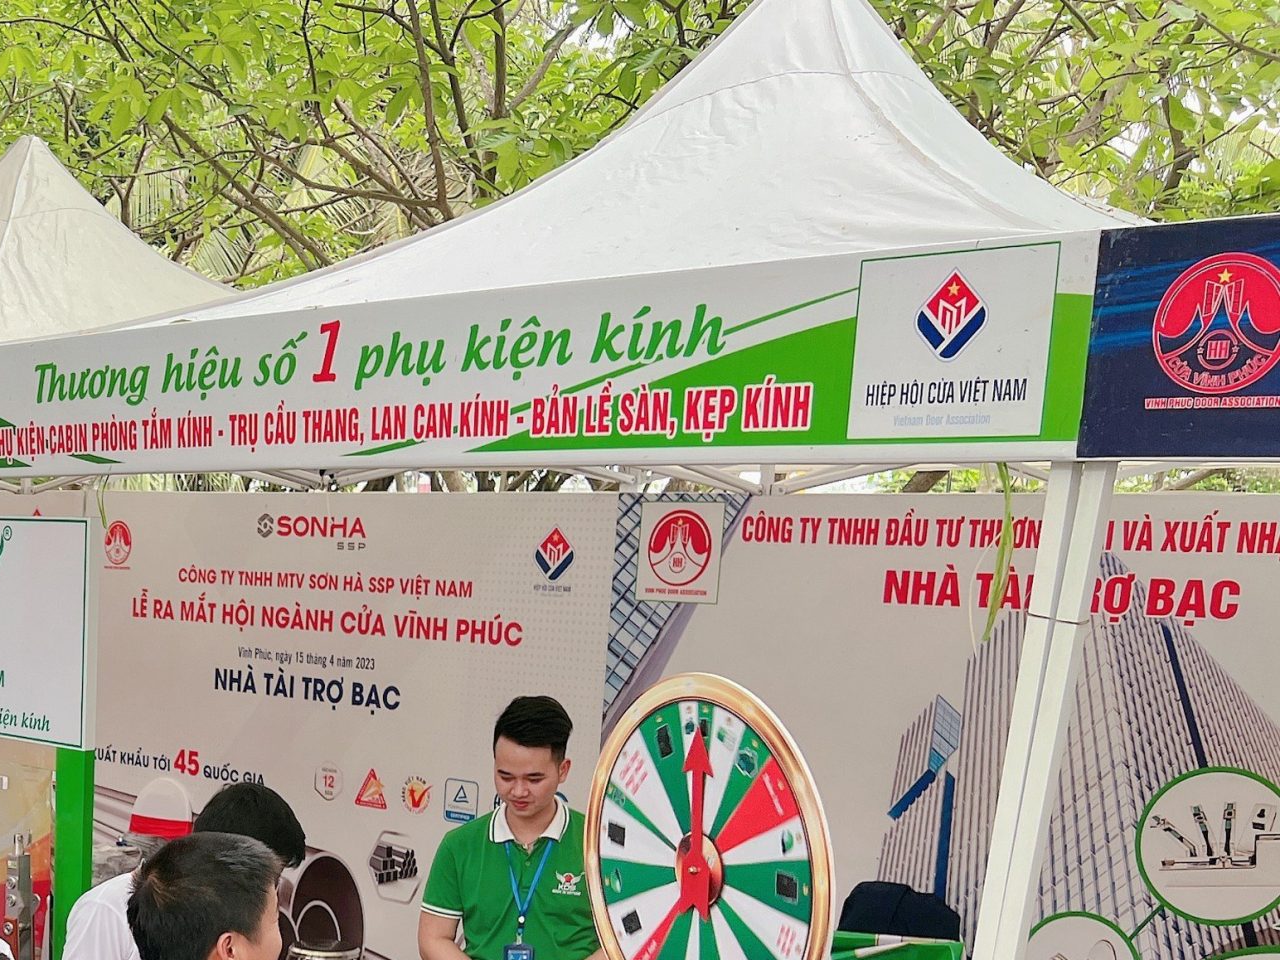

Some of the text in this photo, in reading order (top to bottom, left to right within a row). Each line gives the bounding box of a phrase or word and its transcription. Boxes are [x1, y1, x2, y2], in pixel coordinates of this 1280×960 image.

[34, 304, 726, 407] Thương hiệu số 1 phụ kiện kính
[866, 376, 1028, 408] HIỆP HỘI CỬA VIỆT NAM
[1145, 396, 1280, 409] VINH PHUC DOOR ASSOCIATION
[92, 414, 137, 451] PHÒNG
[142, 407, 172, 450] TẮM
[178, 410, 212, 448] KÍNH
[229, 413, 258, 453] TRỤ
[264, 400, 297, 445] CẦU
[303, 408, 364, 446] THANG,
[371, 404, 407, 441] LAN
[531, 384, 578, 436] BẢN
[584, 381, 615, 434] LỀ
[620, 383, 676, 437] SÀN,
[684, 386, 736, 441] KẸP
[743, 376, 812, 432] KÍNH
[276, 514, 367, 540] SONHA
[741, 510, 793, 544] CÔNG
[799, 517, 822, 544] TY
[828, 517, 880, 546] TNHH
[885, 508, 928, 547] ĐẦU
[936, 516, 966, 548] TƯ
[1123, 513, 1152, 552] VÀ
[1161, 509, 1231, 553] XUẤT
[337, 542, 367, 551] SSP
[178, 564, 473, 600] CÔNG TY TNHH MTV SƠN HÀ SSP VIỆT NAM
[883, 563, 961, 608] NHÀ
[1144, 577, 1241, 627] BẠC
[132, 588, 523, 647] LỄ RA MẮT HỘI NGÀNH CỬA VĨNH PHÚC
[275, 650, 292, 665] ngày
[295, 651, 305, 664] 15
[306, 652, 327, 669] tháng
[329, 654, 335, 667] 4
[355, 657, 375, 671] 2023
[214, 664, 401, 715] NHÀ TÀI TRỢ BẠC
[21, 711, 51, 733] kính
[120, 747, 150, 768] KHẨU
[153, 755, 171, 772] TỚI
[173, 749, 200, 777] 45
[203, 763, 239, 784] QUỐC
[243, 771, 265, 786] GIA
[322, 775, 335, 789] 12
